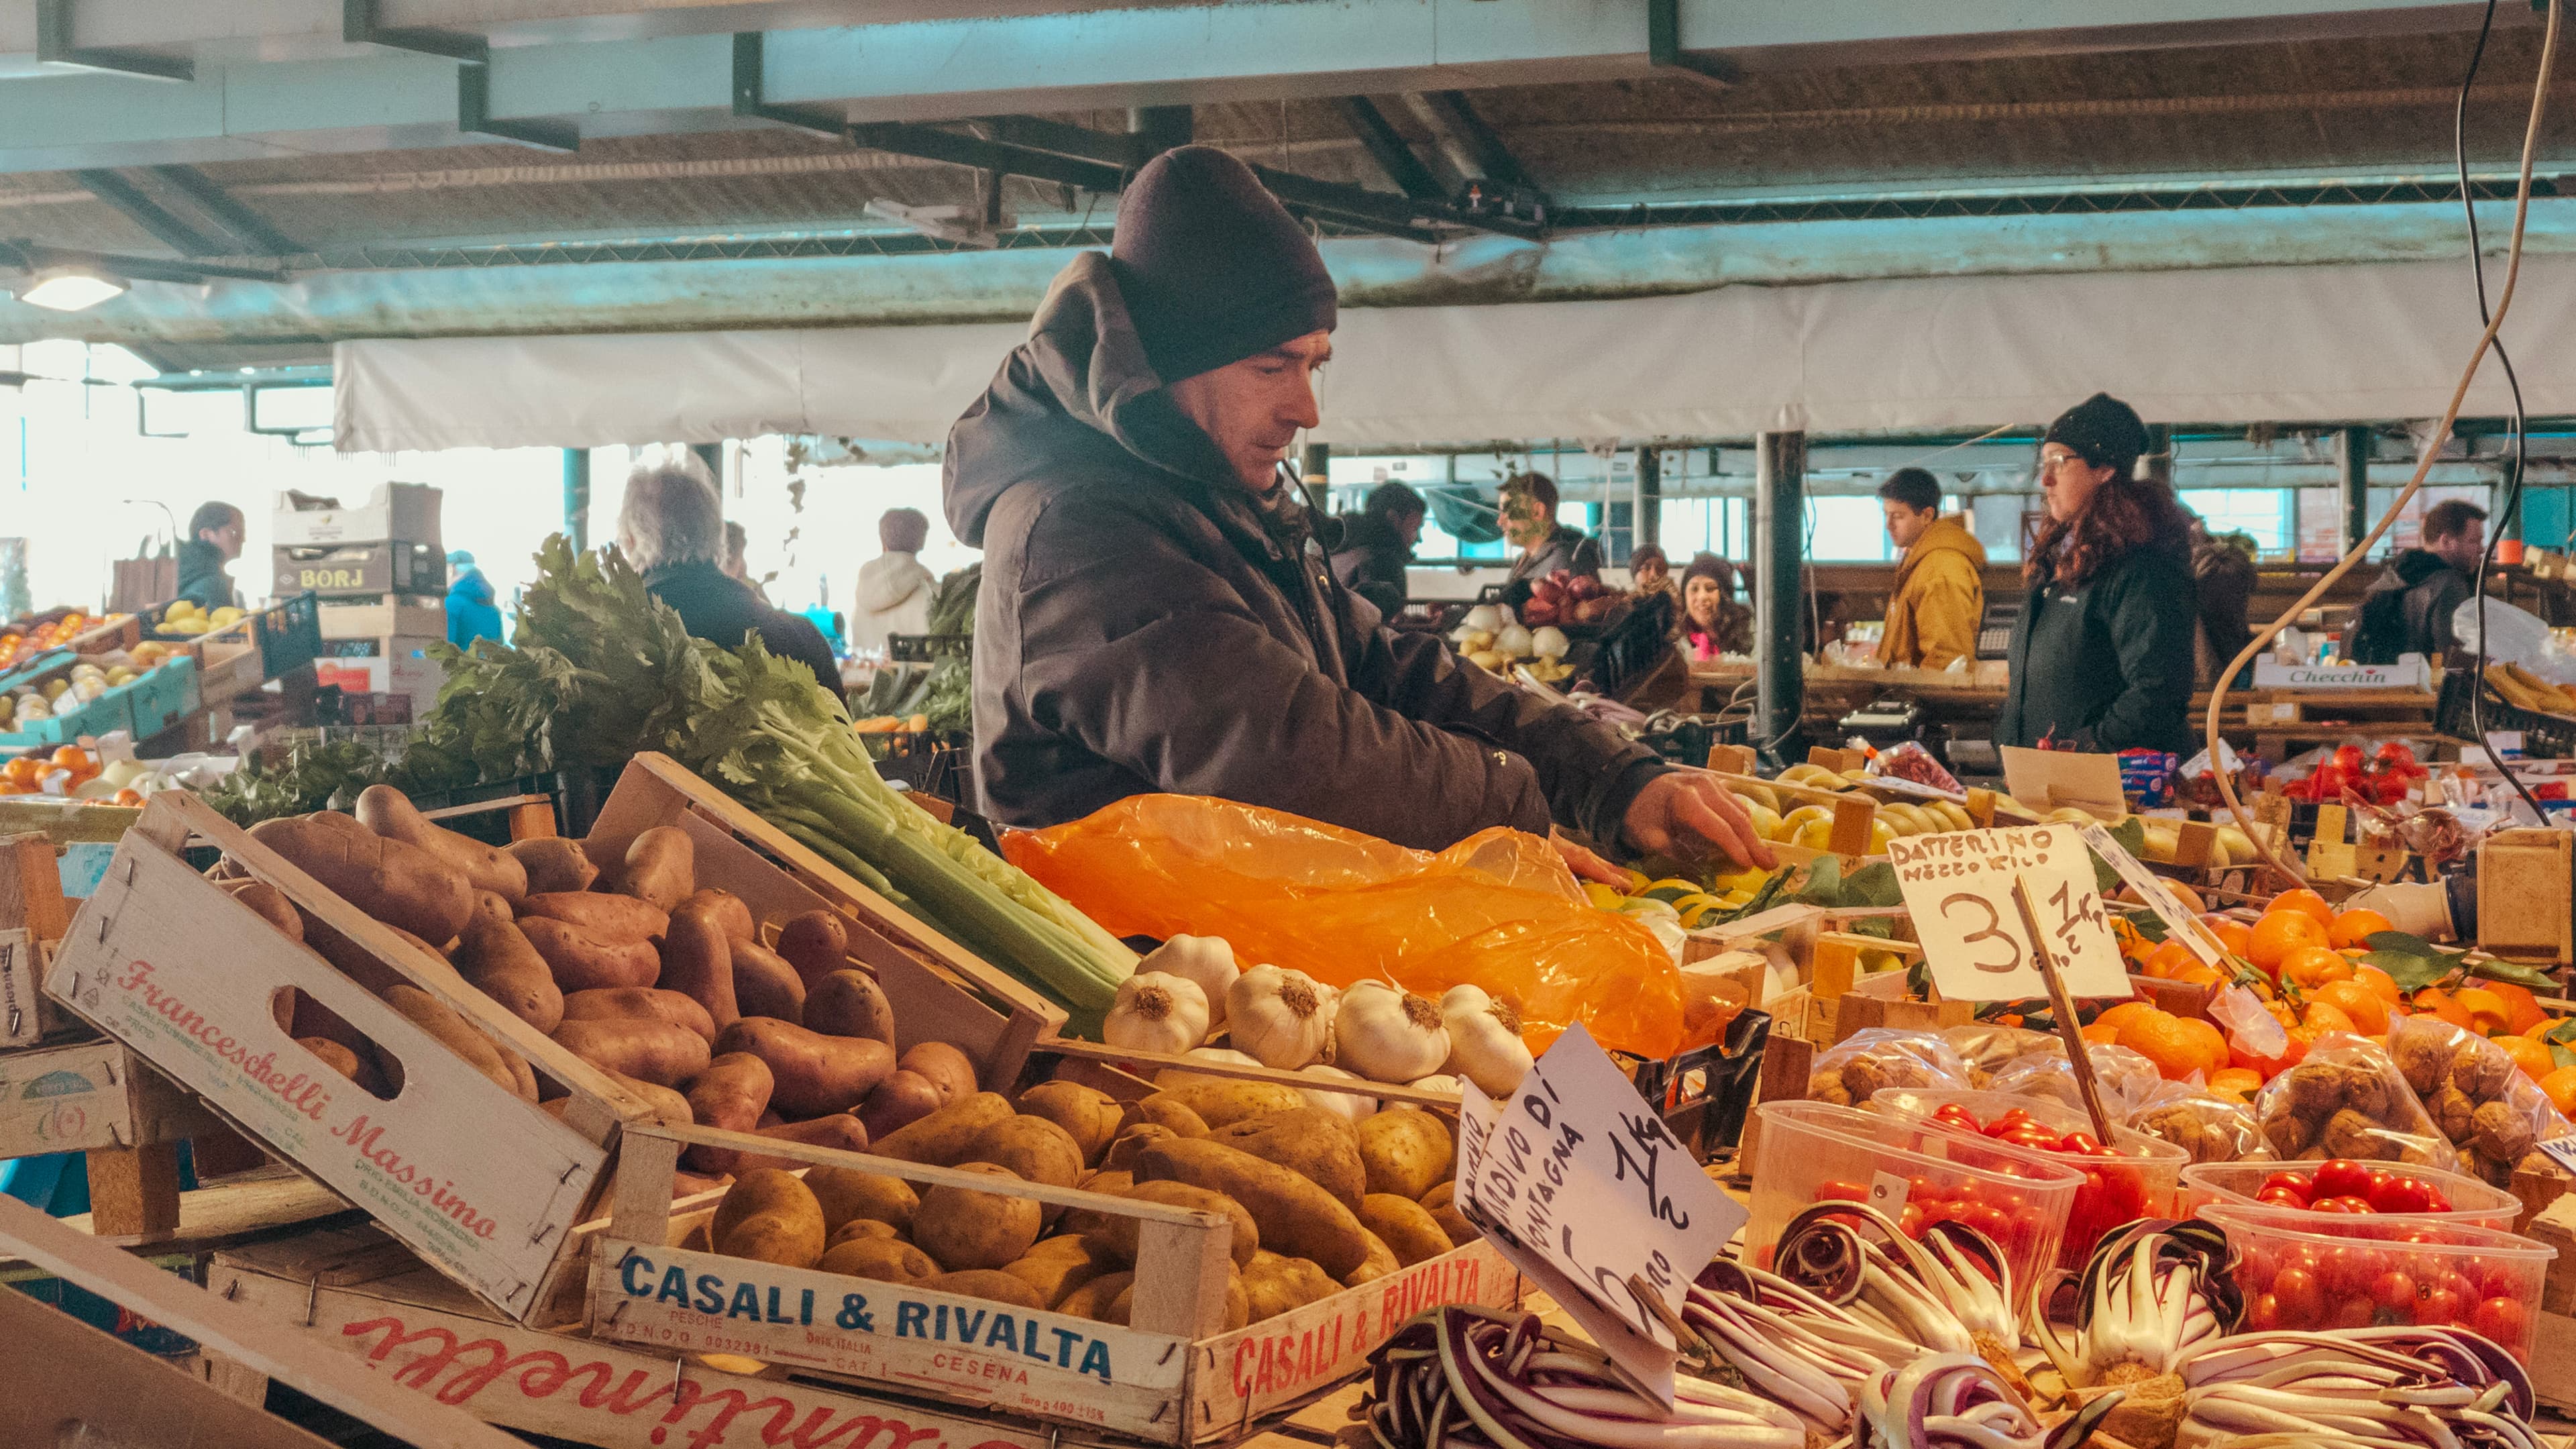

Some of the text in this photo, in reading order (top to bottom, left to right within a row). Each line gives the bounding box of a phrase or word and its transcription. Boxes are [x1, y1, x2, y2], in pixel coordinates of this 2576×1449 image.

[301, 569, 364, 588] BORJ
[2290, 669, 2386, 684] Checchin
[1940, 892, 2021, 973] 3
[117, 959, 332, 1121] Franceschelli
[331, 1114, 496, 1240] Massimo
[621, 1254, 1113, 1386] CASALI & RIVALTA
[671, 1310, 722, 1329] PESCHE
[1233, 1258, 1480, 1399] CASALI & RIVALTA
[932, 1353, 1029, 1385] CESENA
